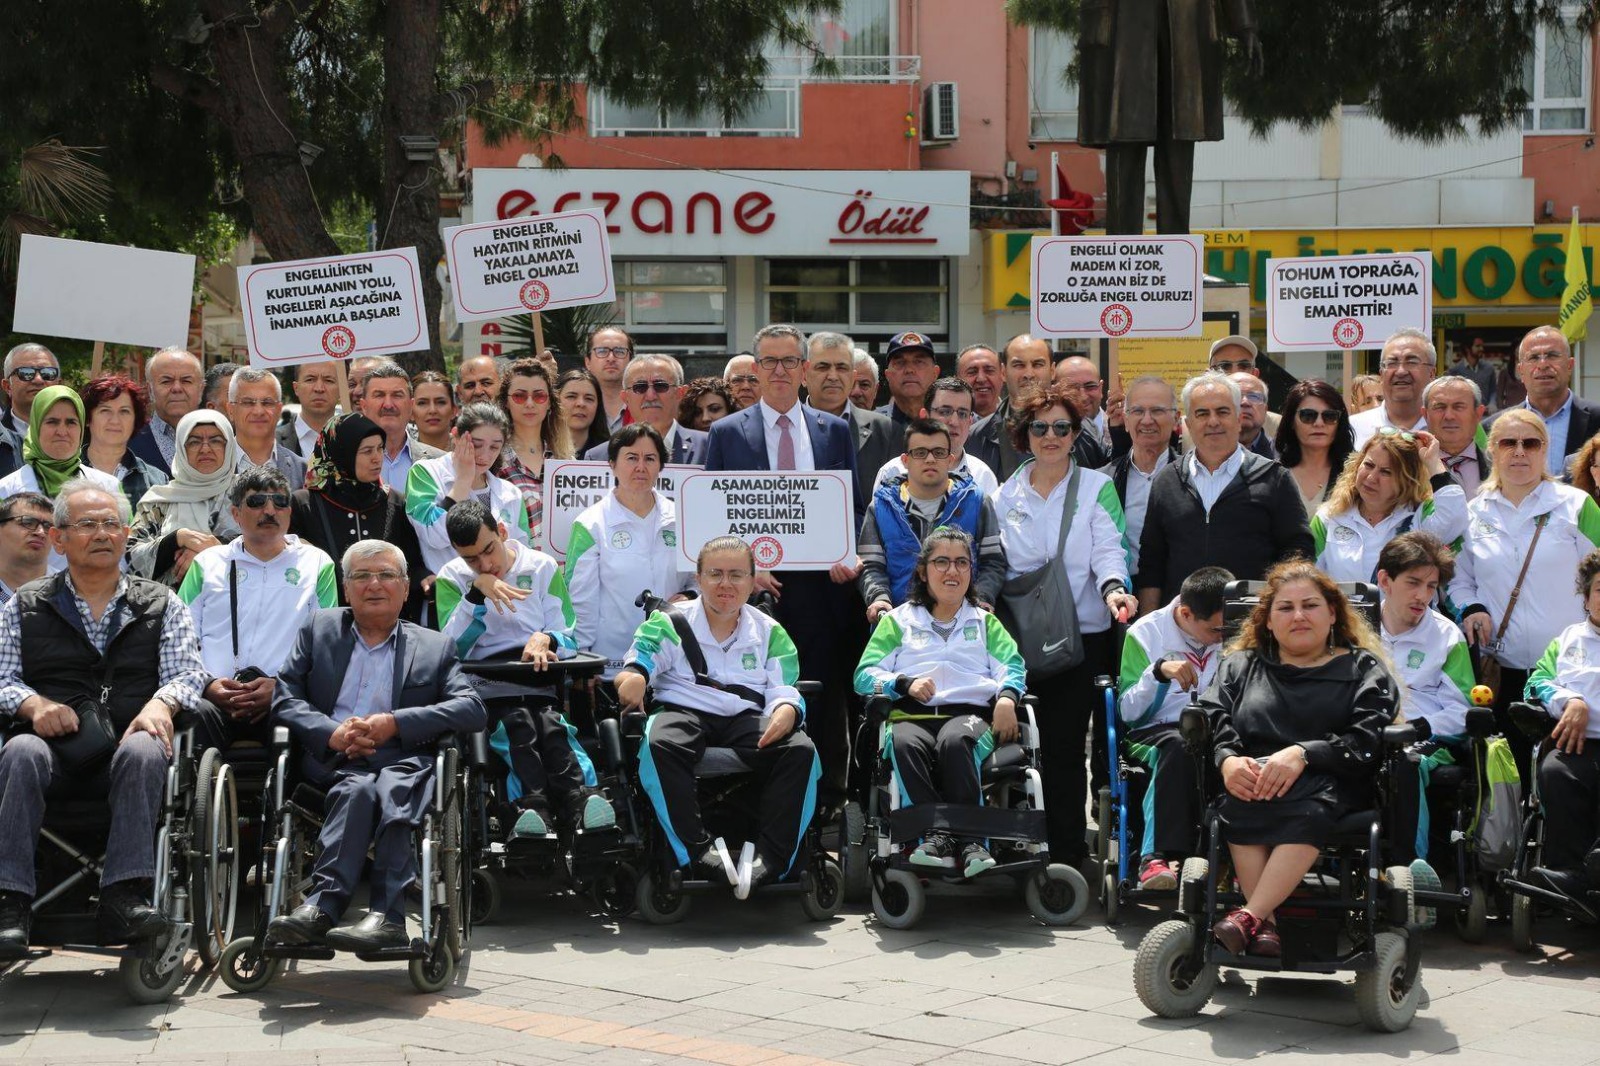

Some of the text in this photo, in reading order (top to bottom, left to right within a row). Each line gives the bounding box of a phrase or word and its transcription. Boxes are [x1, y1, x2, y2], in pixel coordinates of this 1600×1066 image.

[838, 189, 930, 235] Ödül
[493, 222, 558, 240] ENGELLER,
[473, 230, 582, 258] HAYATIN RİTMİNİ
[1070, 242, 1164, 256] ENGELLİ OLMAK
[484, 248, 575, 270] YAKALAMAYA
[1070, 258, 1163, 272] MADEM Kİ ZOR,
[285, 263, 372, 282] ENGELLİLİKTEN
[484, 262, 580, 286] ENGEL OLMAZ!
[1067, 272, 1166, 287] O ZAMAN BİZ DE
[1278, 260, 1419, 281] TOHUM TOPRAĞA,
[266, 276, 396, 300] KURTULMANIN YOLU,
[1040, 290, 1192, 303] ZORLUĞA ENGEL OLURUZ!
[1280, 282, 1418, 300] ENGELLİ TOPLUMA
[264, 290, 402, 315] ENGELLERİ AŞACAĞINA
[1304, 300, 1392, 318] EMANETTİR!
[270, 306, 400, 330] İNANMAKLA BAŞLAR!
[554, 472, 609, 489] ENGELİ
[710, 475, 819, 494] AŞAMADIĞIMIZ
[556, 490, 588, 512] İÇİN
[726, 490, 804, 507] ENGELİMİZ,
[726, 506, 806, 520] ENGELİMİZİ
[728, 522, 805, 538] AŞMAKTIR!
